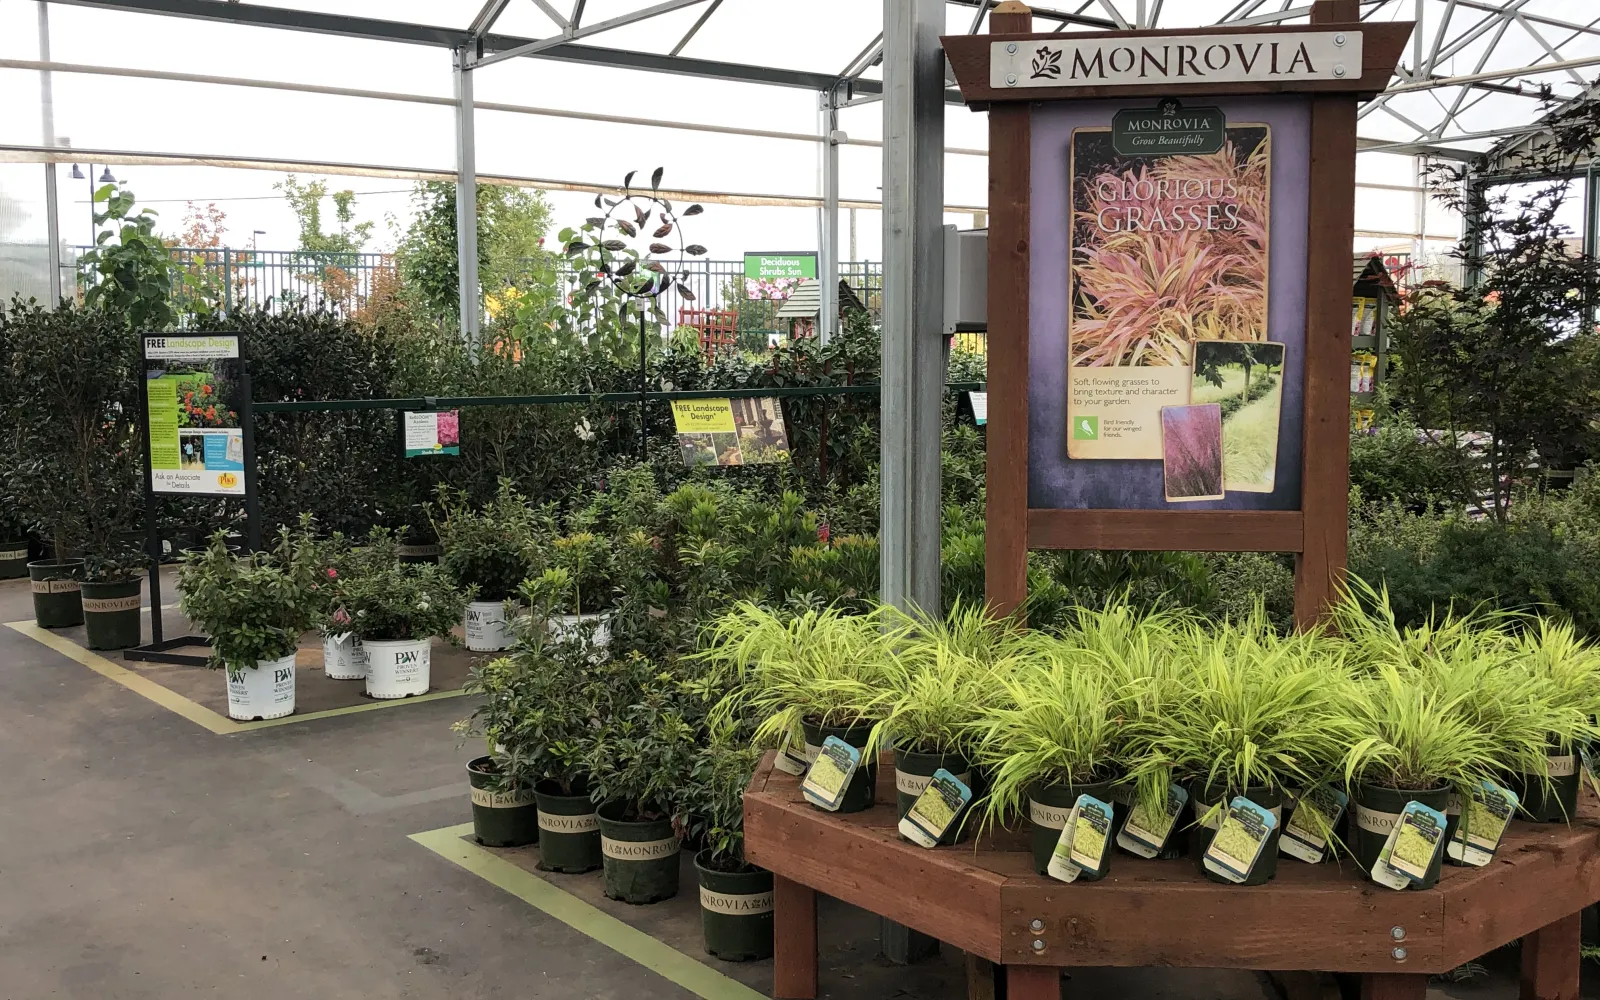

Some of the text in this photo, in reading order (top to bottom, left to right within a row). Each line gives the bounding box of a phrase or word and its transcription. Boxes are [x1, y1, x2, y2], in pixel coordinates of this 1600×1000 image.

[1069, 41, 1318, 80] MONROVIA
[1127, 118, 1210, 131] MONROVIA
[1132, 134, 1204, 147] Grow Beautifully
[1098, 177, 1238, 202] GLORIOUS
[1098, 203, 1238, 232] GRASSES
[761, 257, 800, 266] Deciduous
[760, 267, 802, 276] Shrubs Sun
[147, 337, 235, 350] FREE Landscape Design
[1073, 378, 1160, 388] Soft, flowing grasses to
[1073, 387, 1178, 397] bring texture and character
[1084, 399, 1102, 407] your
[1103, 398, 1132, 407] garden.
[675, 404, 729, 413] FREE Landscape
[1123, 425, 1142, 433] winged
[171, 481, 190, 489] Details
[541, 817, 583, 829] NROVIA
[702, 894, 750, 910] NROVIA
